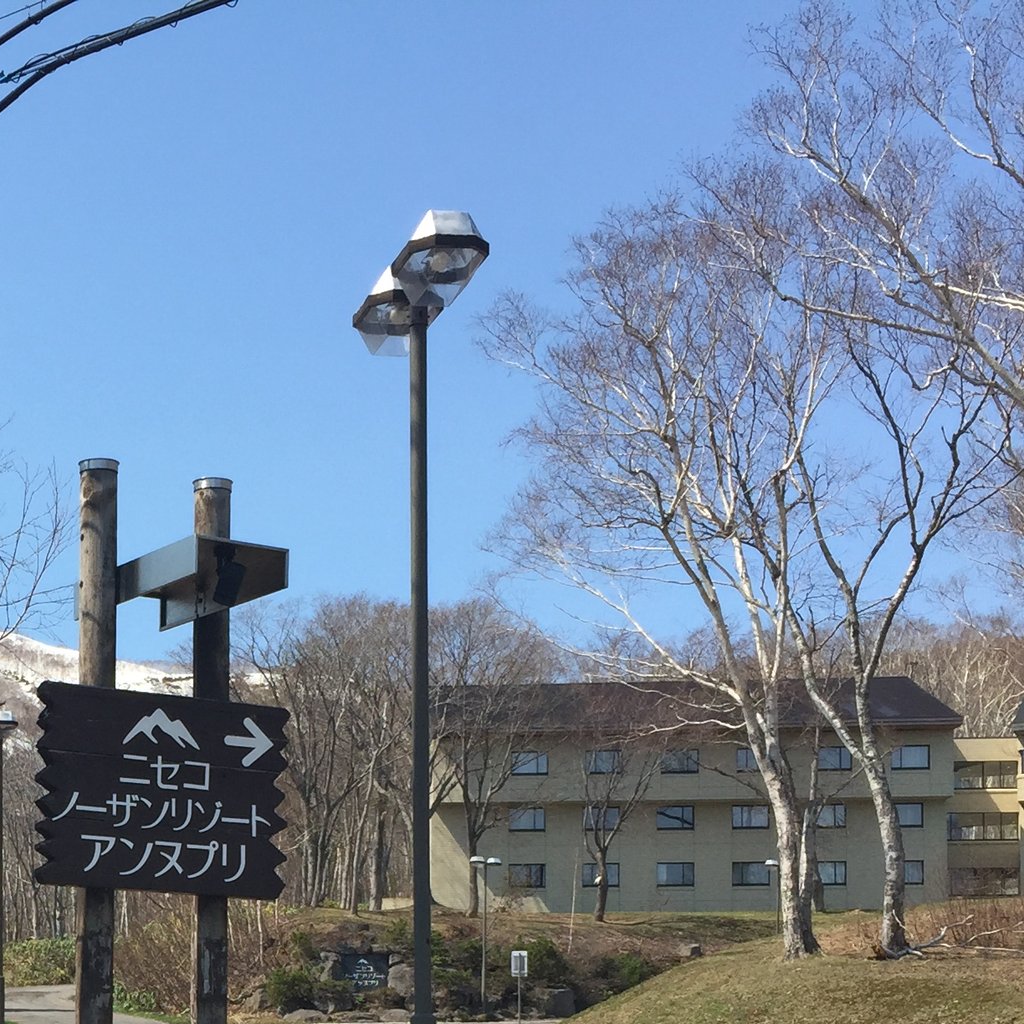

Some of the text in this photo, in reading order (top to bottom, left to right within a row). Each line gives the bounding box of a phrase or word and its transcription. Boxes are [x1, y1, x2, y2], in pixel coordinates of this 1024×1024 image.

[119, 755, 210, 790] ニセコ
[51, 791, 271, 837] ノーザンリゾート
[80, 834, 246, 882] アンヌプリ
